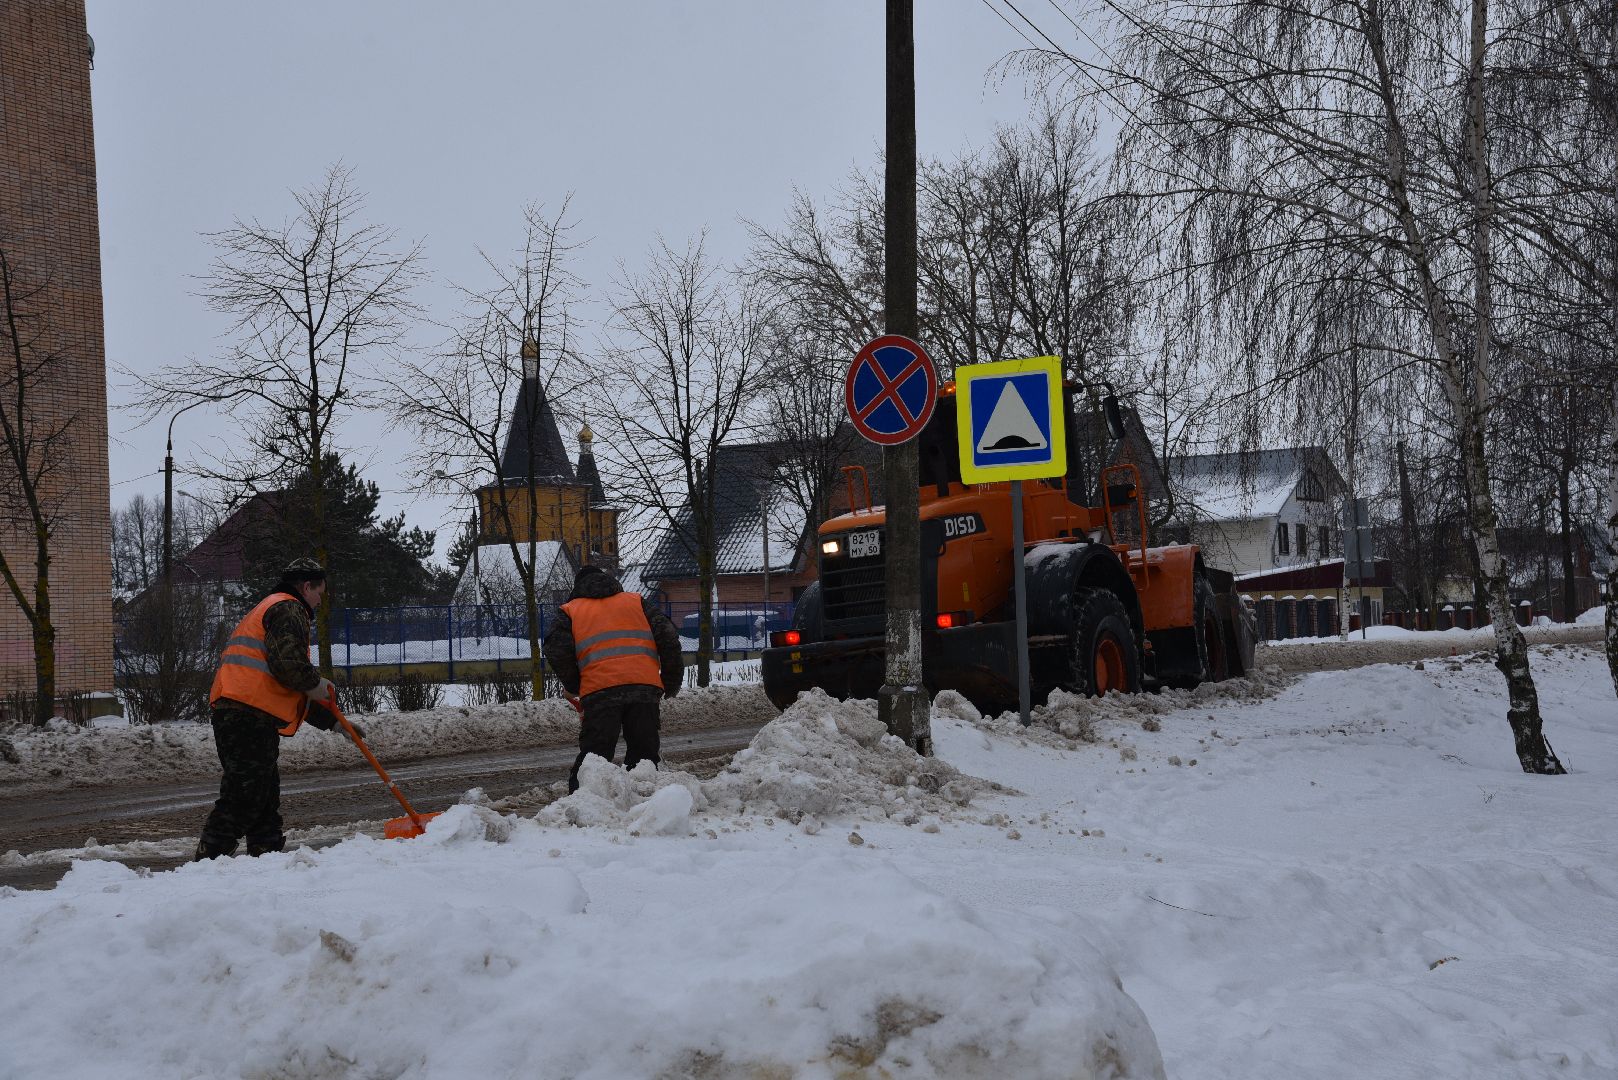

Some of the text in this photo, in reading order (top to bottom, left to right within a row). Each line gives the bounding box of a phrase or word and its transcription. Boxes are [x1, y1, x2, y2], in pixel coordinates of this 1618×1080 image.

[944, 515, 977, 537] DISD
[852, 532, 876, 545] 8219
[868, 545, 878, 554] 50
